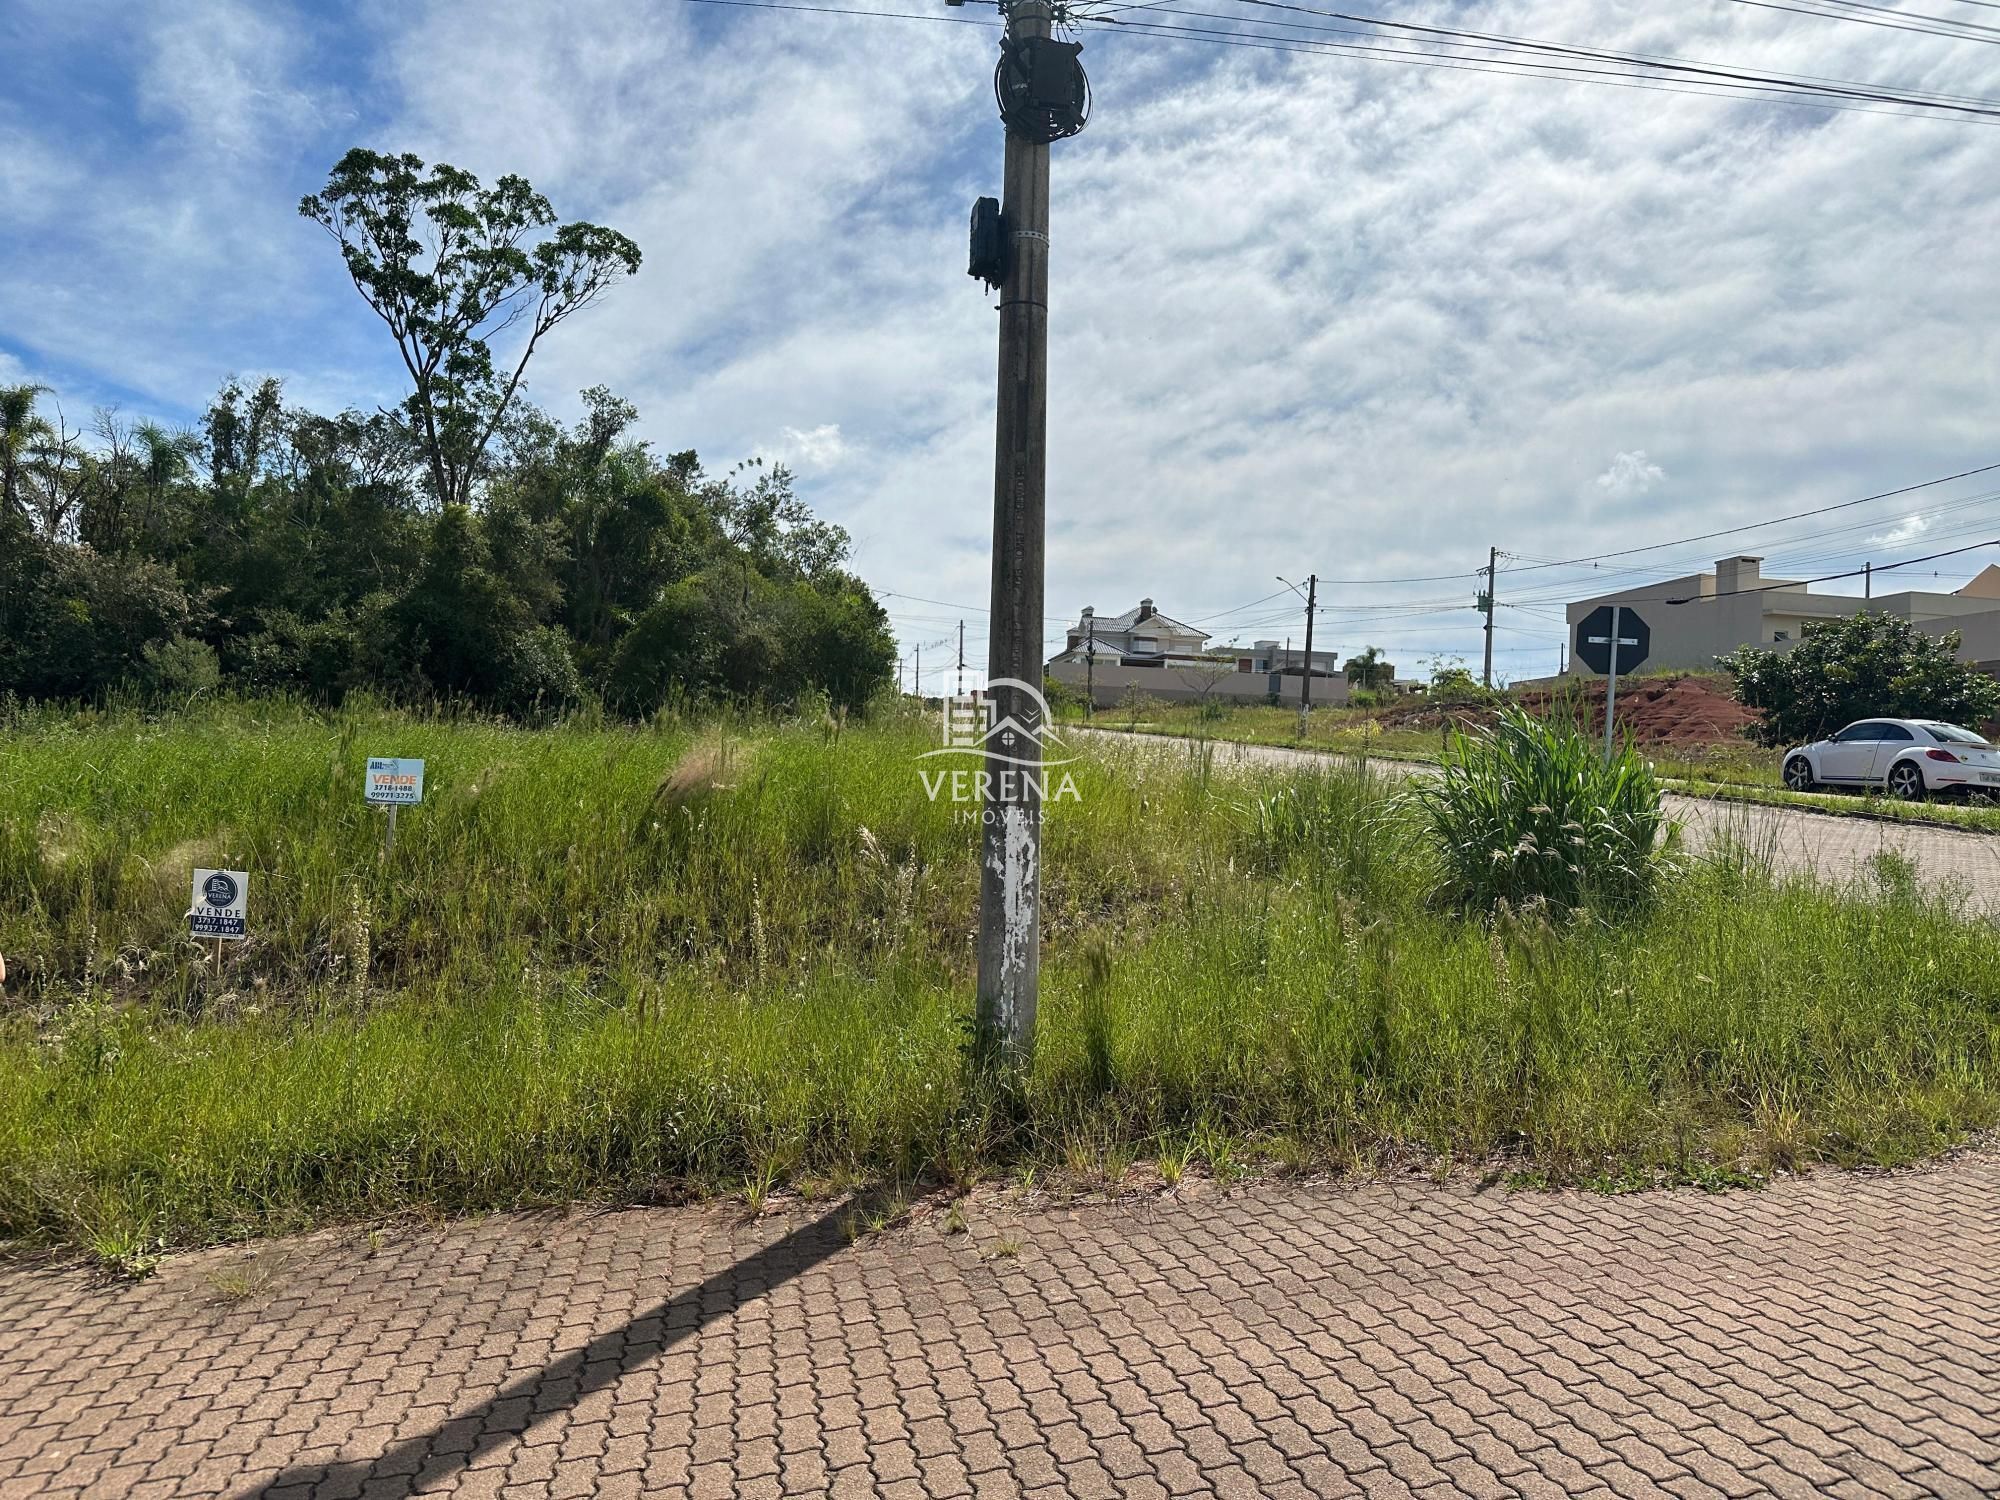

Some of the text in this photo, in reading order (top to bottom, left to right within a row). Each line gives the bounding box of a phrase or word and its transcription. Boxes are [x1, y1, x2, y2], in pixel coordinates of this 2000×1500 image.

[373, 775, 417, 784] VENDE
[197, 907, 241, 917] VENDE
[198, 917, 238, 925] 3717.1847
[195, 925, 239, 933] 99937.1847
